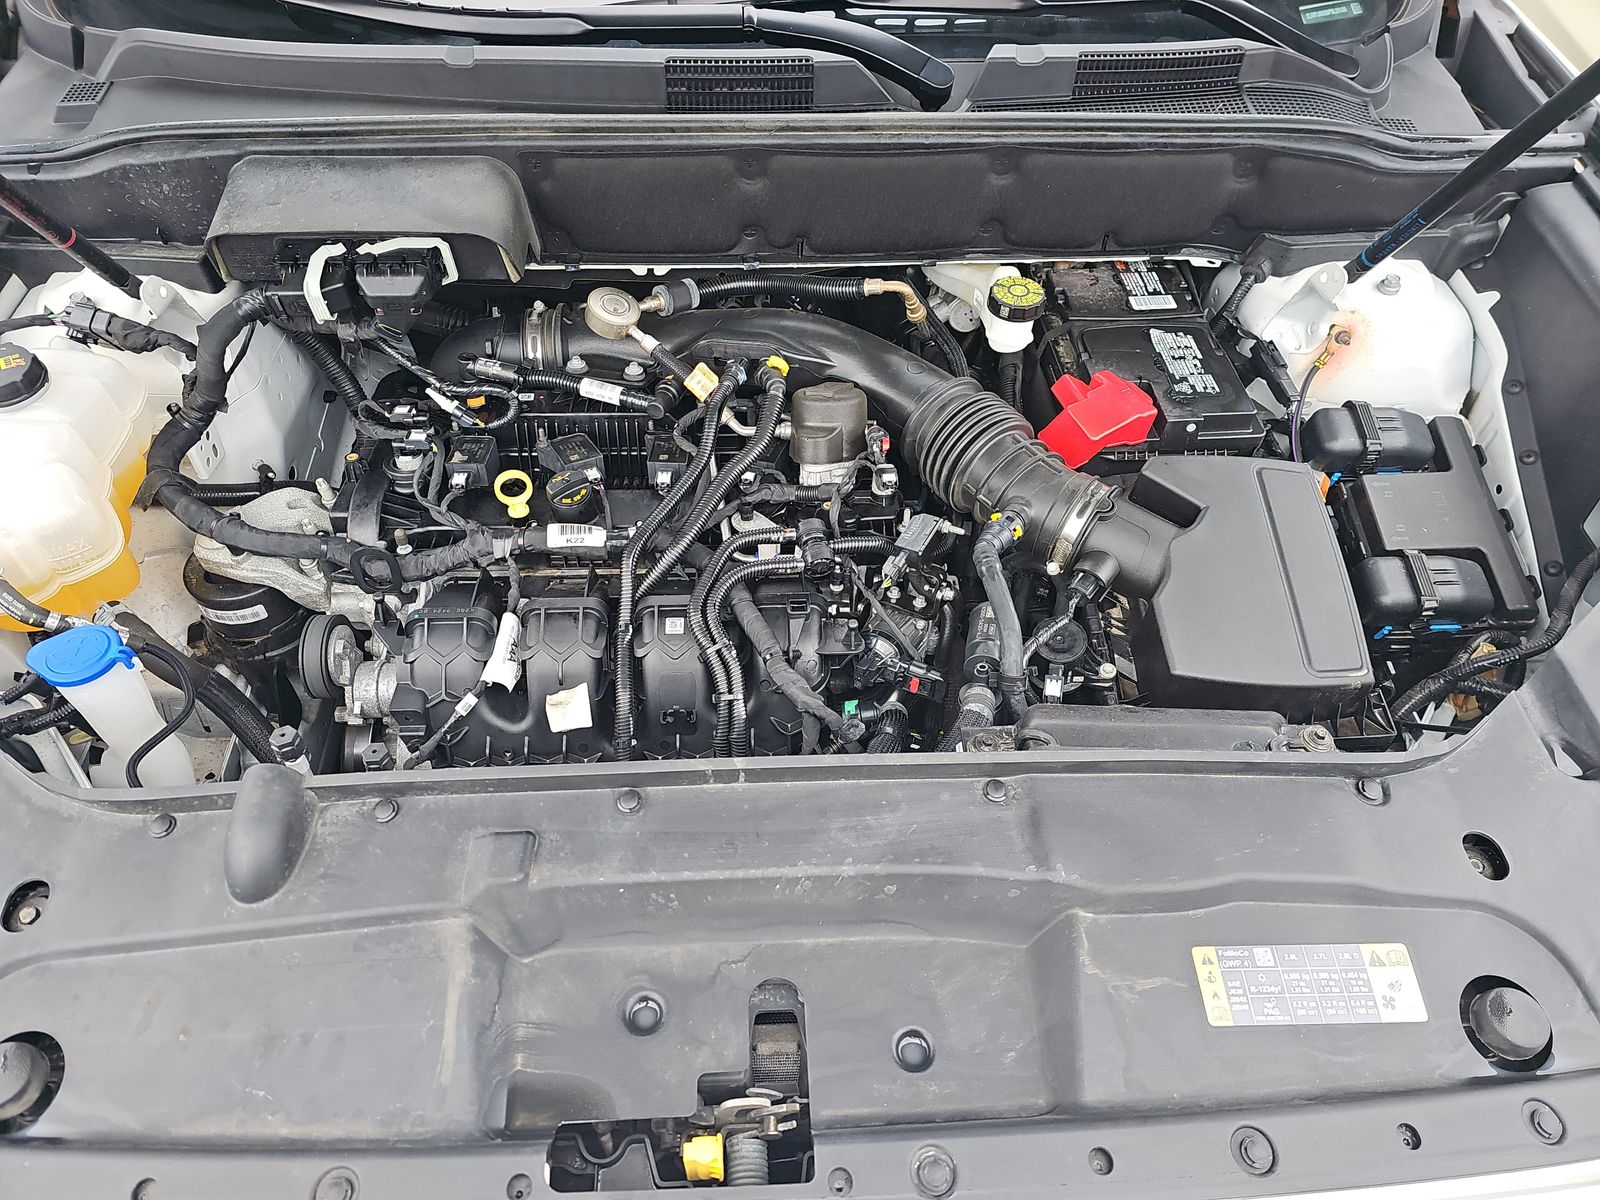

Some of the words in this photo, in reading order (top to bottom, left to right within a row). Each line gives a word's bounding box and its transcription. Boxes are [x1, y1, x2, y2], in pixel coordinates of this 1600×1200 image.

[1218, 949, 1250, 958] FoMoCo
[1219, 960, 1242, 969] (GWP
[1243, 960, 1252, 969] 4)
